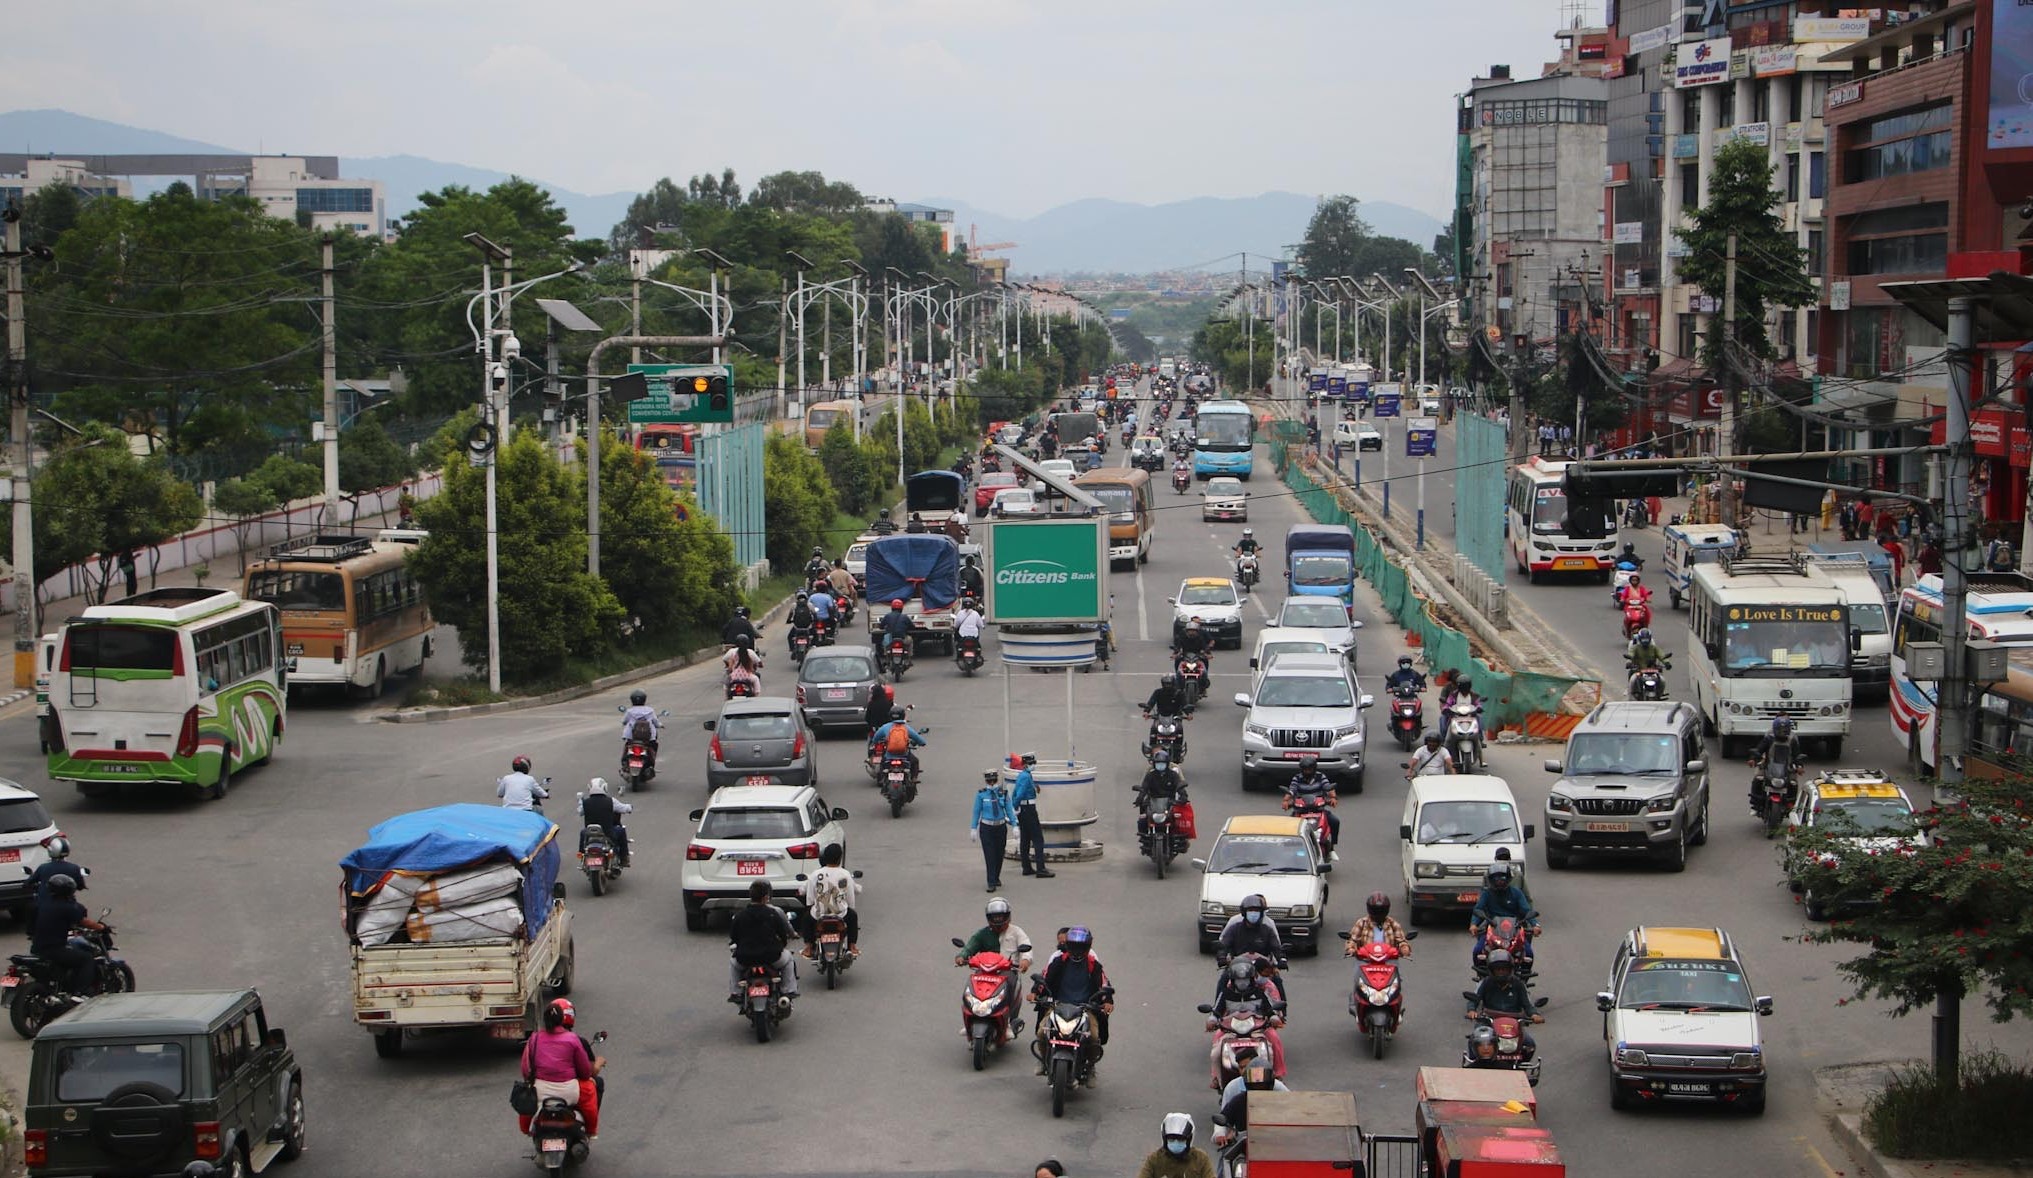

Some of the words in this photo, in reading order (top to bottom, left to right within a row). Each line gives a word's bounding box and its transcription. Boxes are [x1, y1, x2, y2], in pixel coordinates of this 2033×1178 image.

[1495, 109, 1546, 120] NOBLE
[996, 570, 1068, 585] Citizens
[1071, 572, 1096, 580] Bank
[1744, 607, 1777, 620] Love
[1780, 608, 1793, 620] Is
[1796, 608, 1829, 621] True
[1655, 962, 1728, 971] SUZUKI
